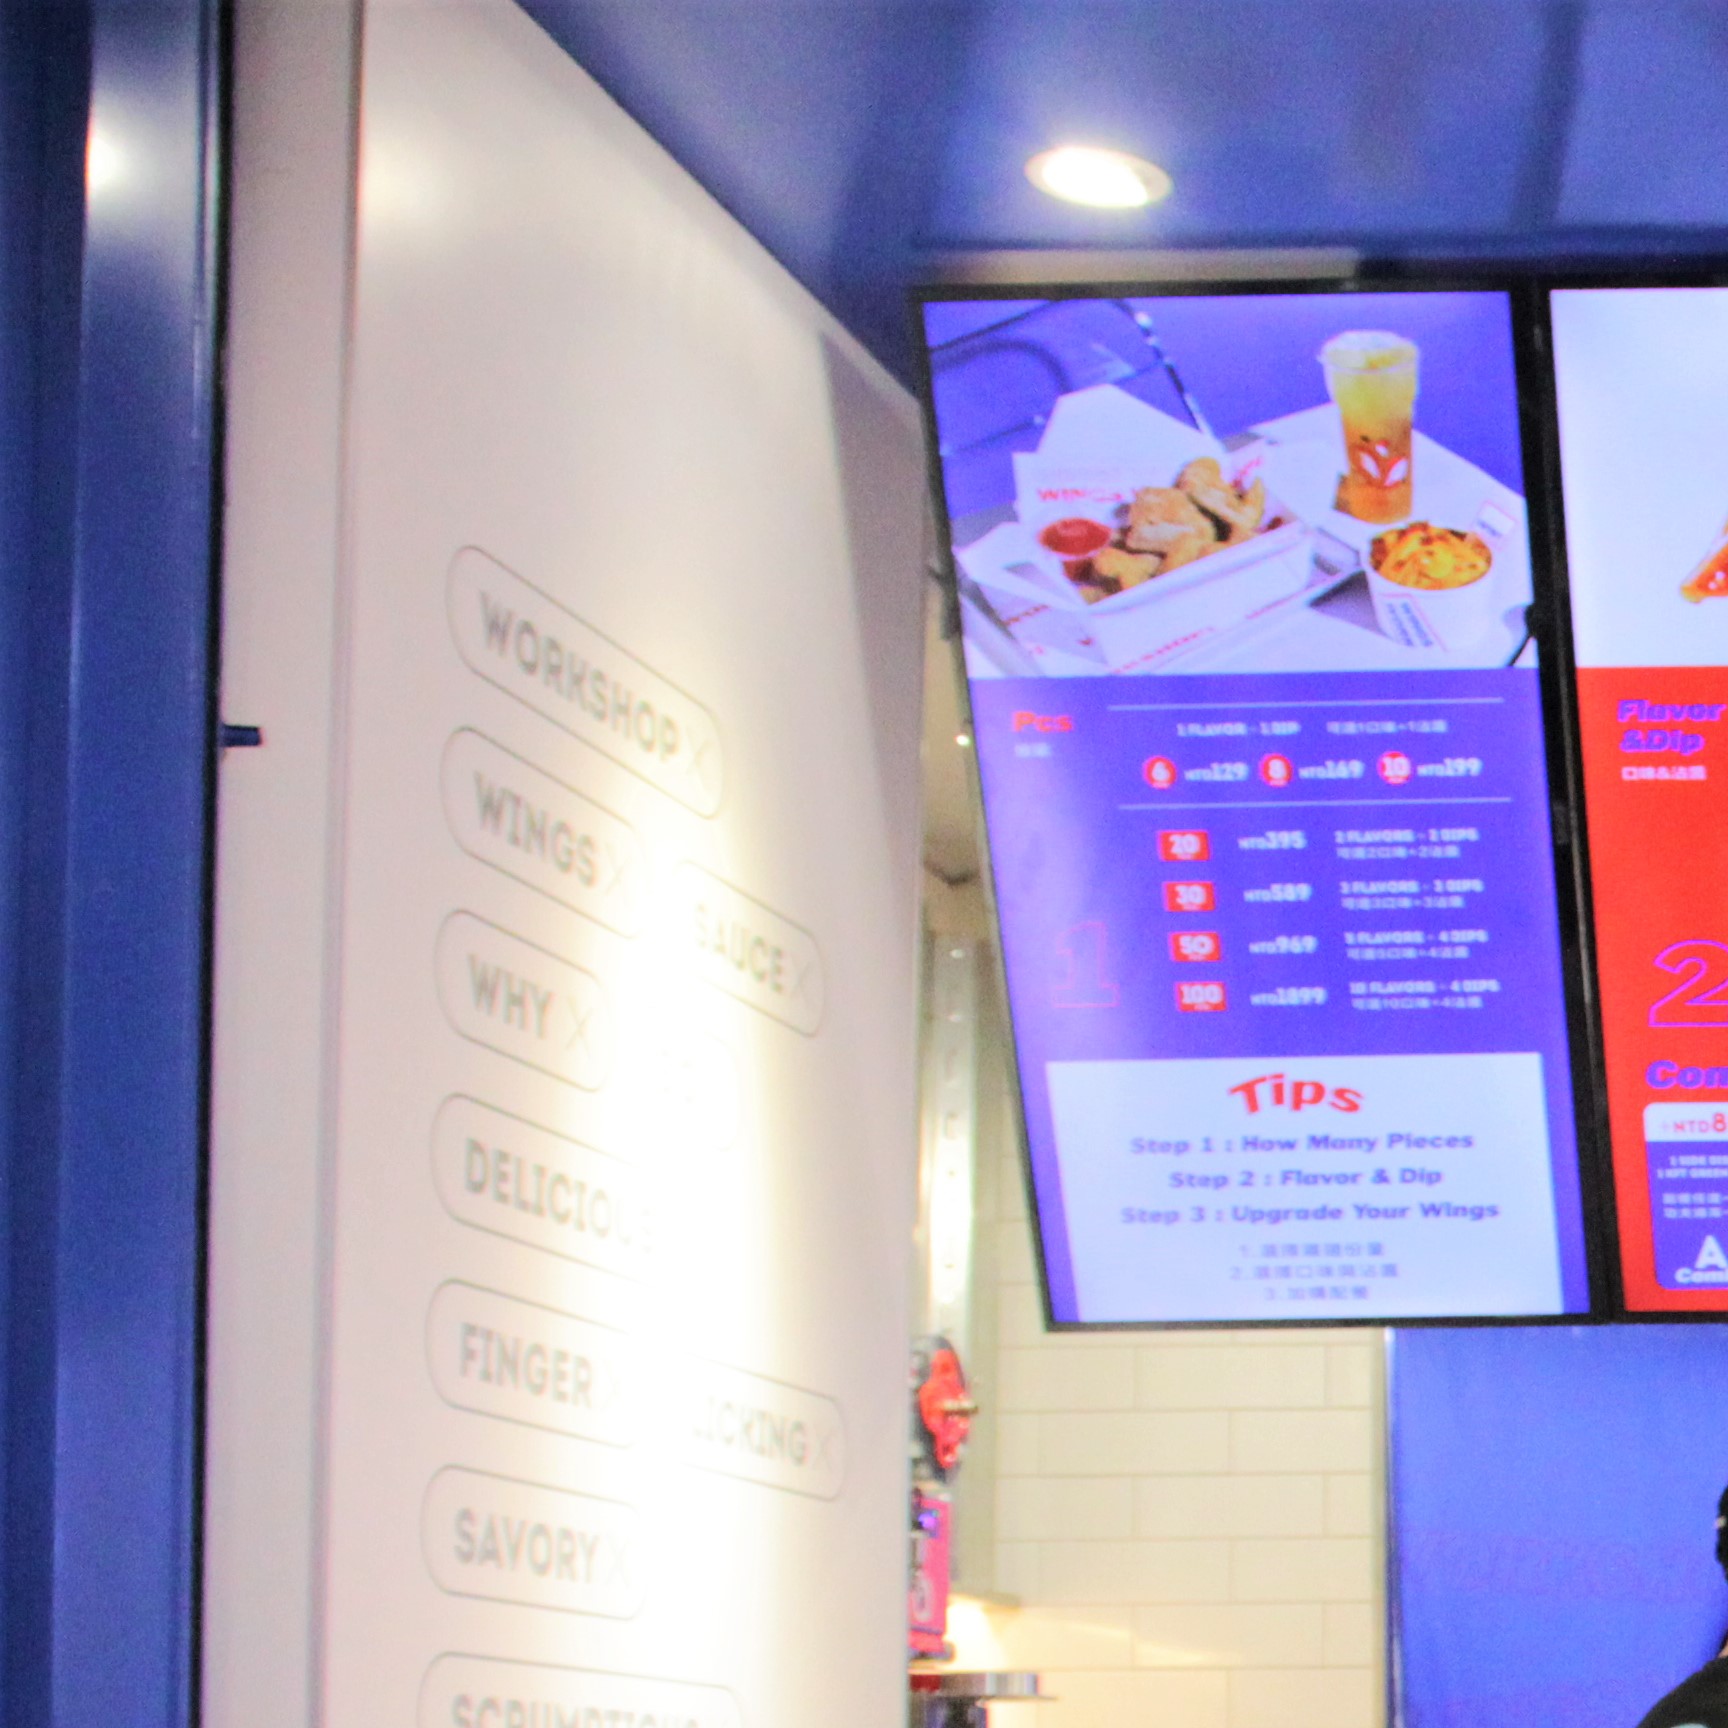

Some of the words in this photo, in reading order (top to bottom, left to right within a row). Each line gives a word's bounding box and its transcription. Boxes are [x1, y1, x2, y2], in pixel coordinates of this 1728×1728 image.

[480, 592, 680, 762] WORKSHOP
[1013, 711, 1073, 732] Pcs
[1617, 699, 1727, 723] Flavor
[474, 772, 596, 888] WINGS
[1169, 834, 1200, 855] 20
[1179, 935, 1213, 955] 50
[467, 953, 554, 1039] WHY
[1182, 984, 1224, 1005] 100
[1228, 1073, 1364, 1114] Tips
[1130, 1137, 1189, 1156] Step
[1242, 1135, 1297, 1151] How
[1306, 1134, 1377, 1153] Many
[1388, 1132, 1474, 1150] Pieces
[1168, 1171, 1228, 1190] Step
[1280, 1169, 1362, 1186] Flavor
[1400, 1167, 1443, 1186] Dip
[1121, 1206, 1179, 1226] Step
[1232, 1204, 1342, 1224] Upgrade
[1354, 1203, 1410, 1219] Your
[1420, 1202, 1501, 1221] Wings
[458, 1321, 592, 1405] FINGER
[453, 1508, 601, 1584] SAVORY
